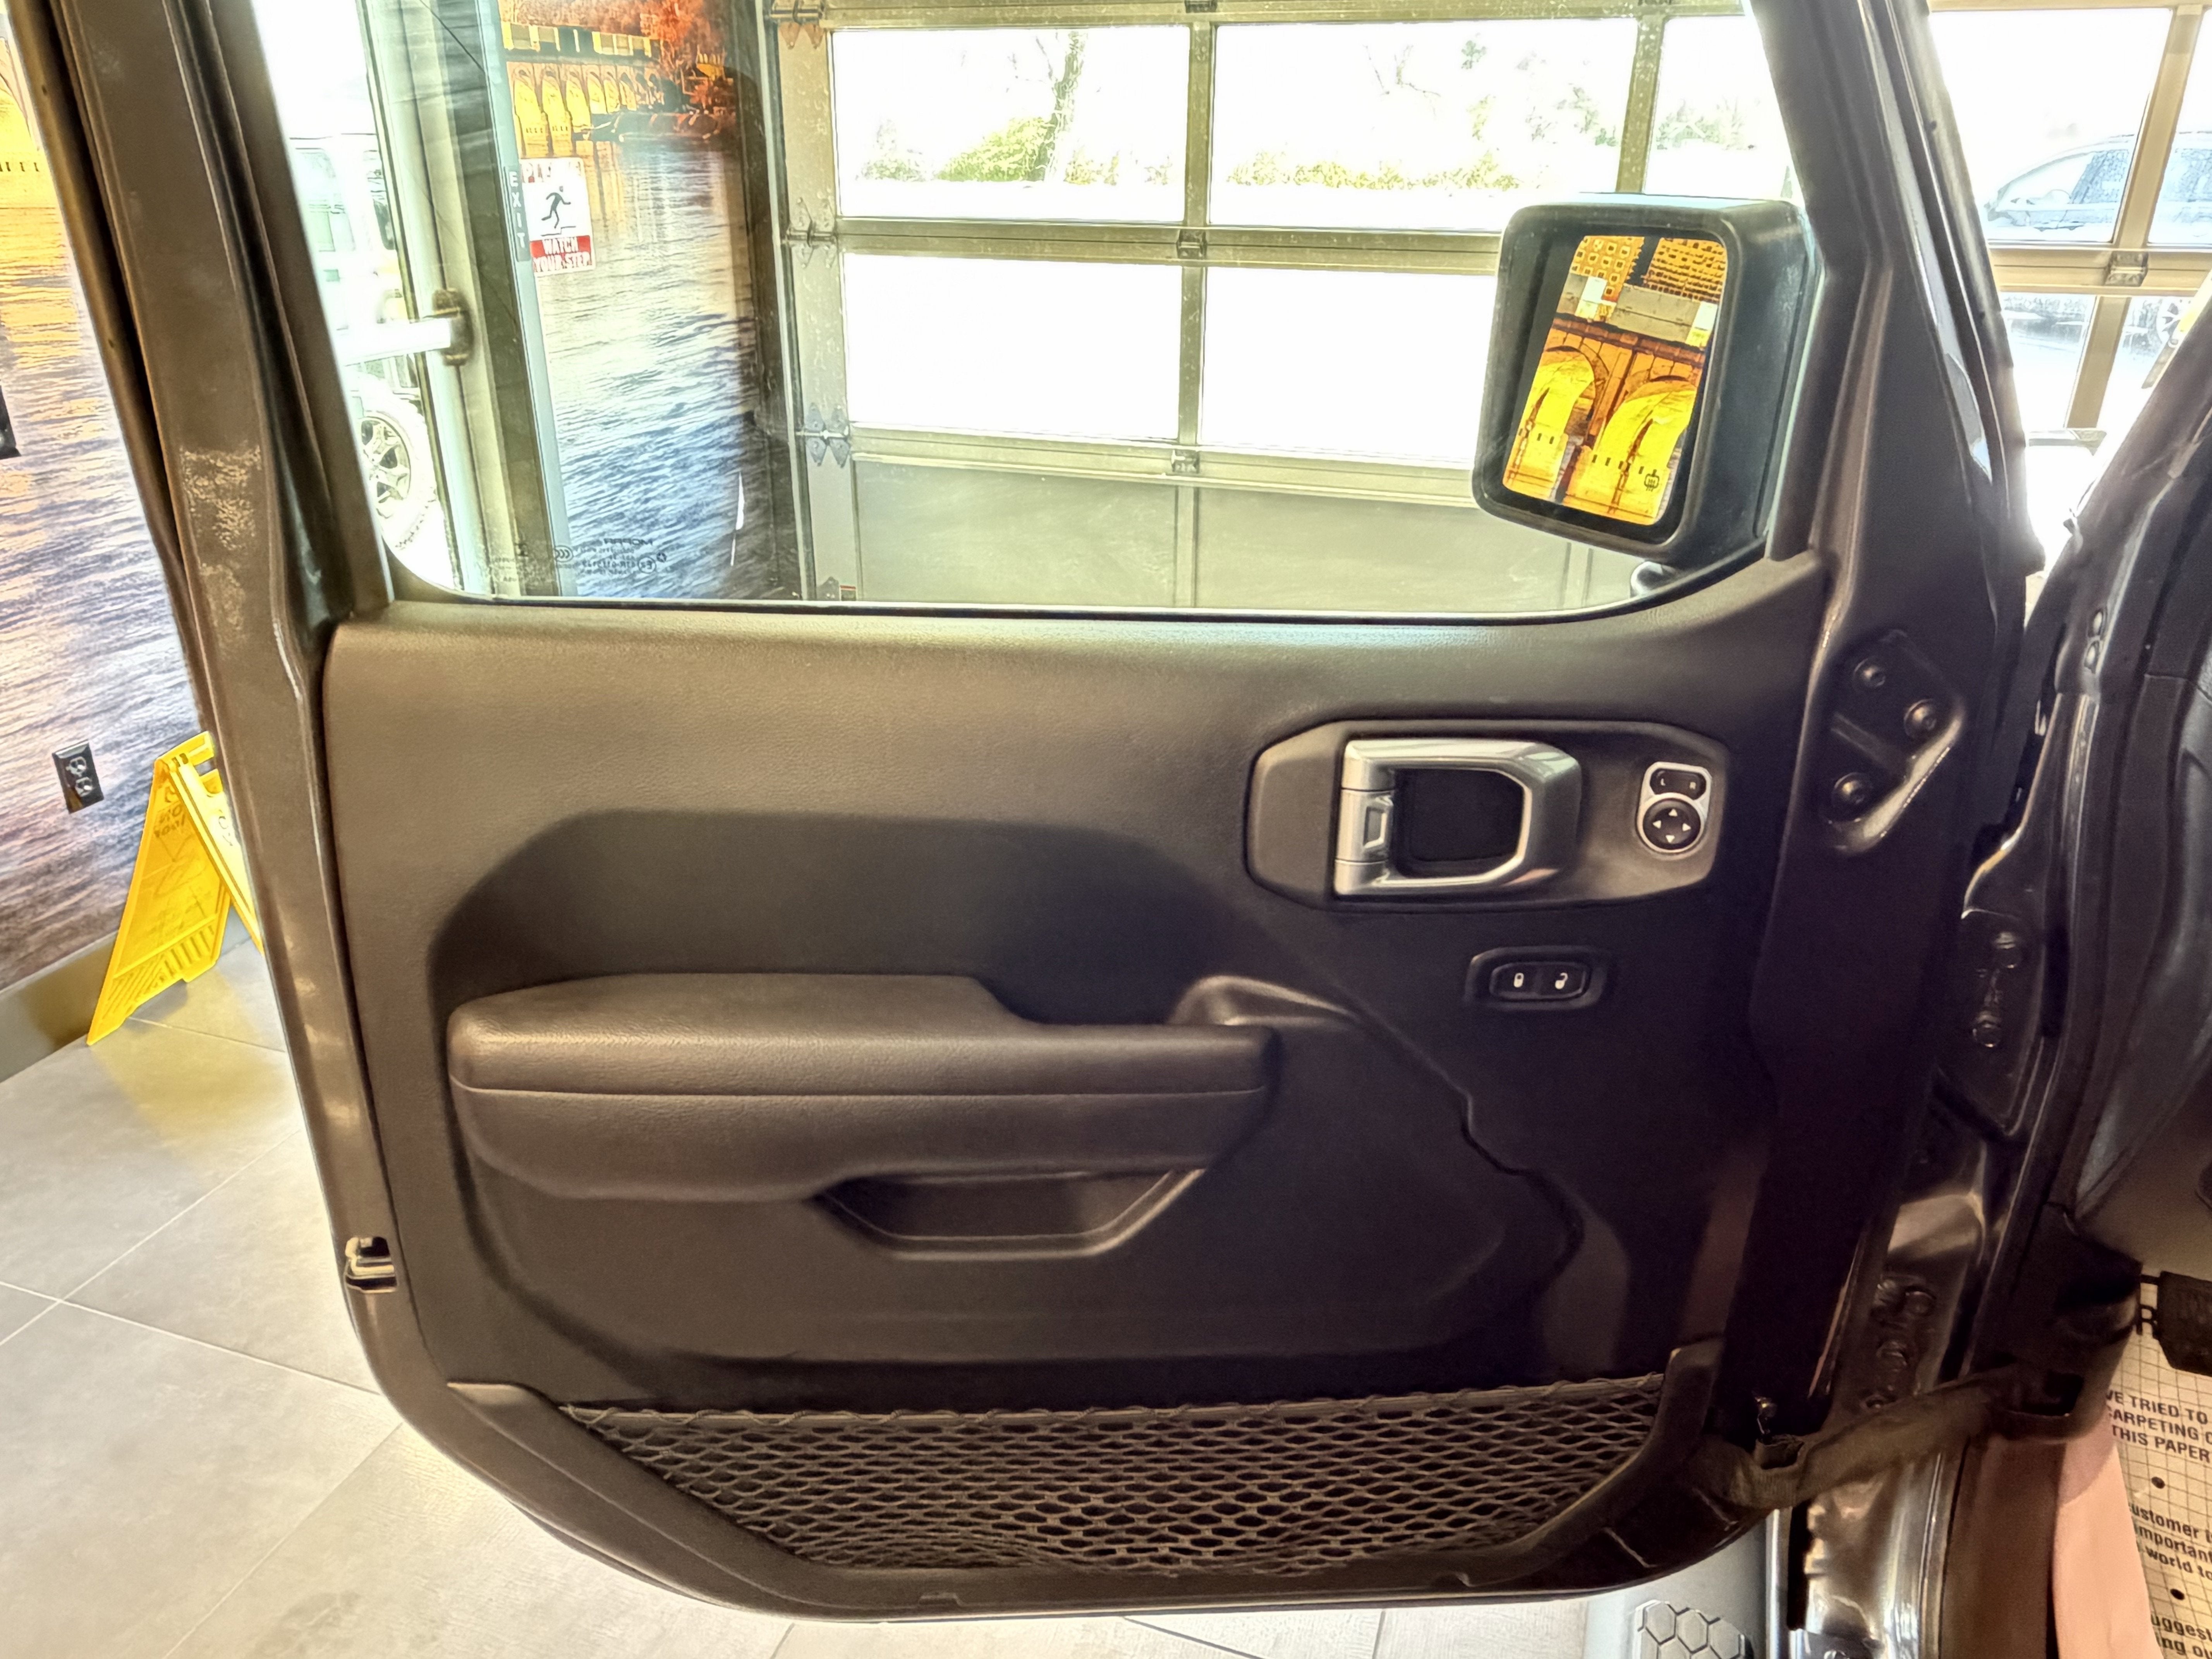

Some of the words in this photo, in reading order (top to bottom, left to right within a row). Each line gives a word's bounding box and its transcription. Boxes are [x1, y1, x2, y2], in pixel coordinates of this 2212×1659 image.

[509, 171, 525, 248] EXIT
[542, 237, 579, 255] WATCH
[564, 251, 591, 270] STEP
[1660, 778, 1666, 786] L
[1689, 781, 1697, 790] R
[2128, 1395, 2179, 1418] TRIED
[2185, 1408, 2208, 1425] TO
[2112, 1424, 2148, 1446] THIS
[2155, 1436, 2210, 1463] PAPER
[2129, 1502, 2199, 1539] ustomer
[2145, 1546, 2194, 1574] world
